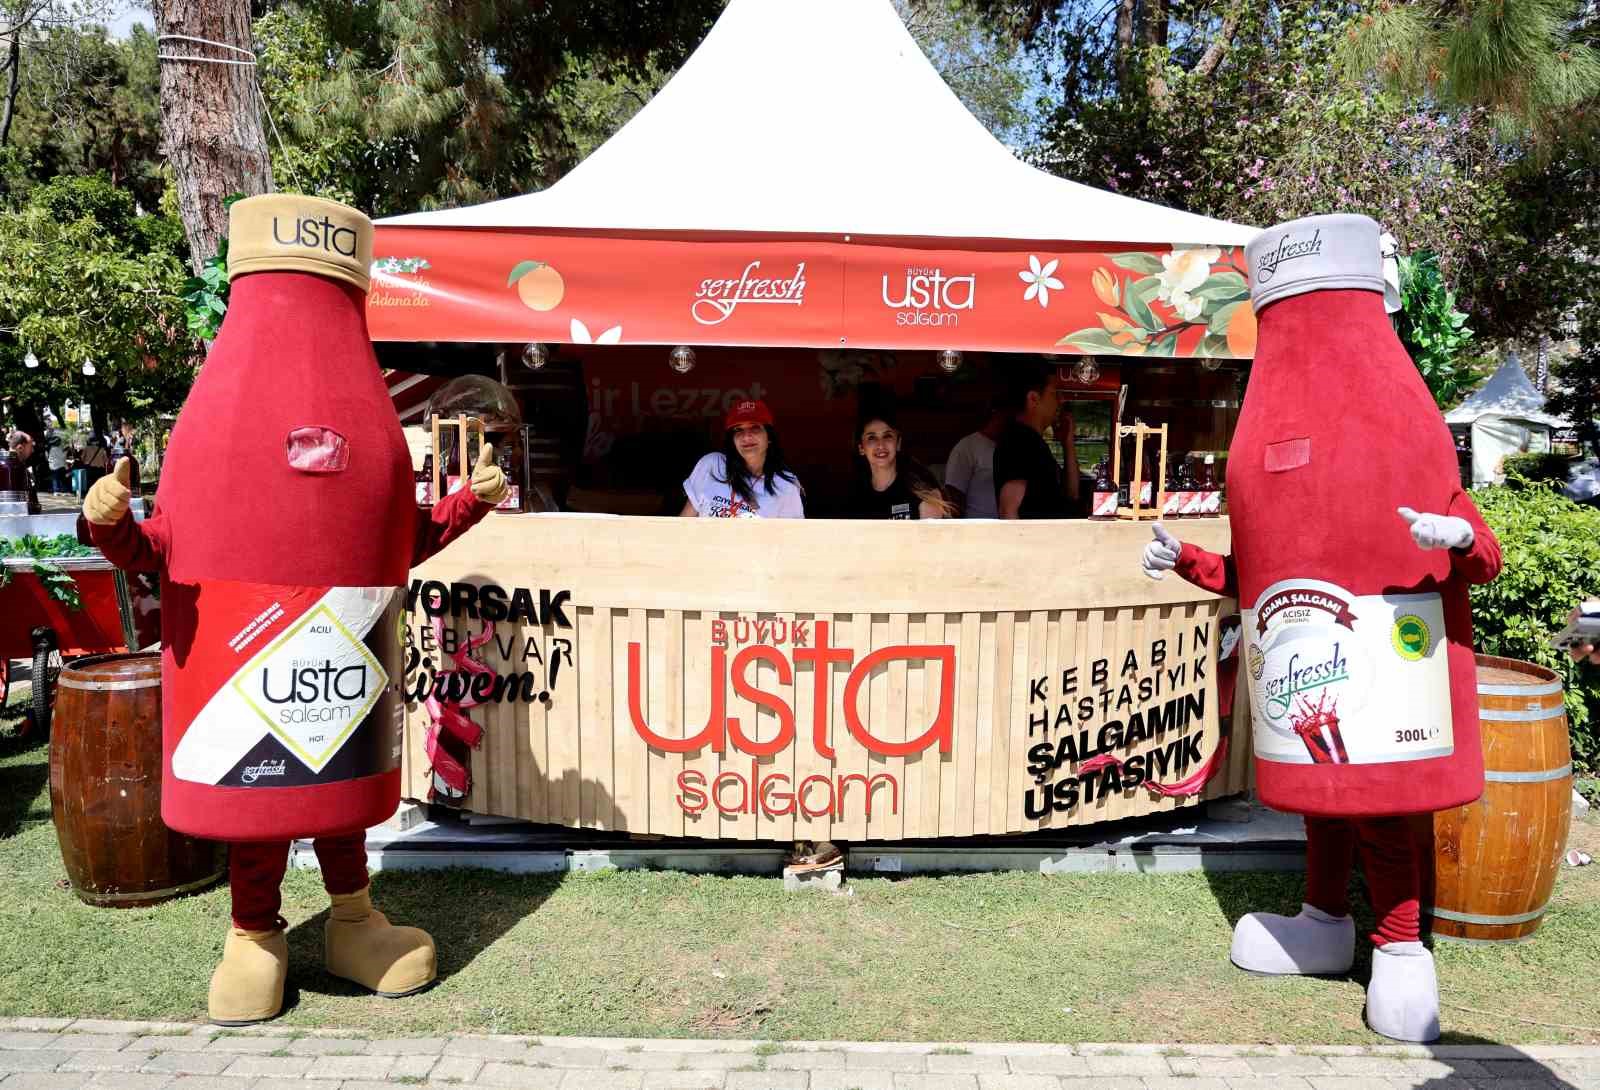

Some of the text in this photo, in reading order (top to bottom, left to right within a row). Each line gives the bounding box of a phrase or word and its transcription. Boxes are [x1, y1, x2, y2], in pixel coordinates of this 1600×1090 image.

[273, 216, 357, 259] usta
[1257, 228, 1323, 284] serfressh
[691, 260, 806, 325] serfressh
[882, 268, 976, 310] usta
[711, 617, 808, 645] BÜYÜK
[1262, 593, 1343, 621] ADANA ŞALGAMI
[495, 633, 573, 667] VAR
[1030, 622, 1209, 705] KEBABIN
[262, 660, 367, 704] usta
[627, 620, 956, 761] usta
[1029, 655, 1207, 737] HASTASIYIK
[1264, 641, 1350, 721] serfressh
[308, 735, 324, 744] HOT
[1027, 688, 1206, 784] ŞALGAMIN
[1394, 728, 1428, 743] 300L
[1024, 730, 1204, 820] USTASIYIK
